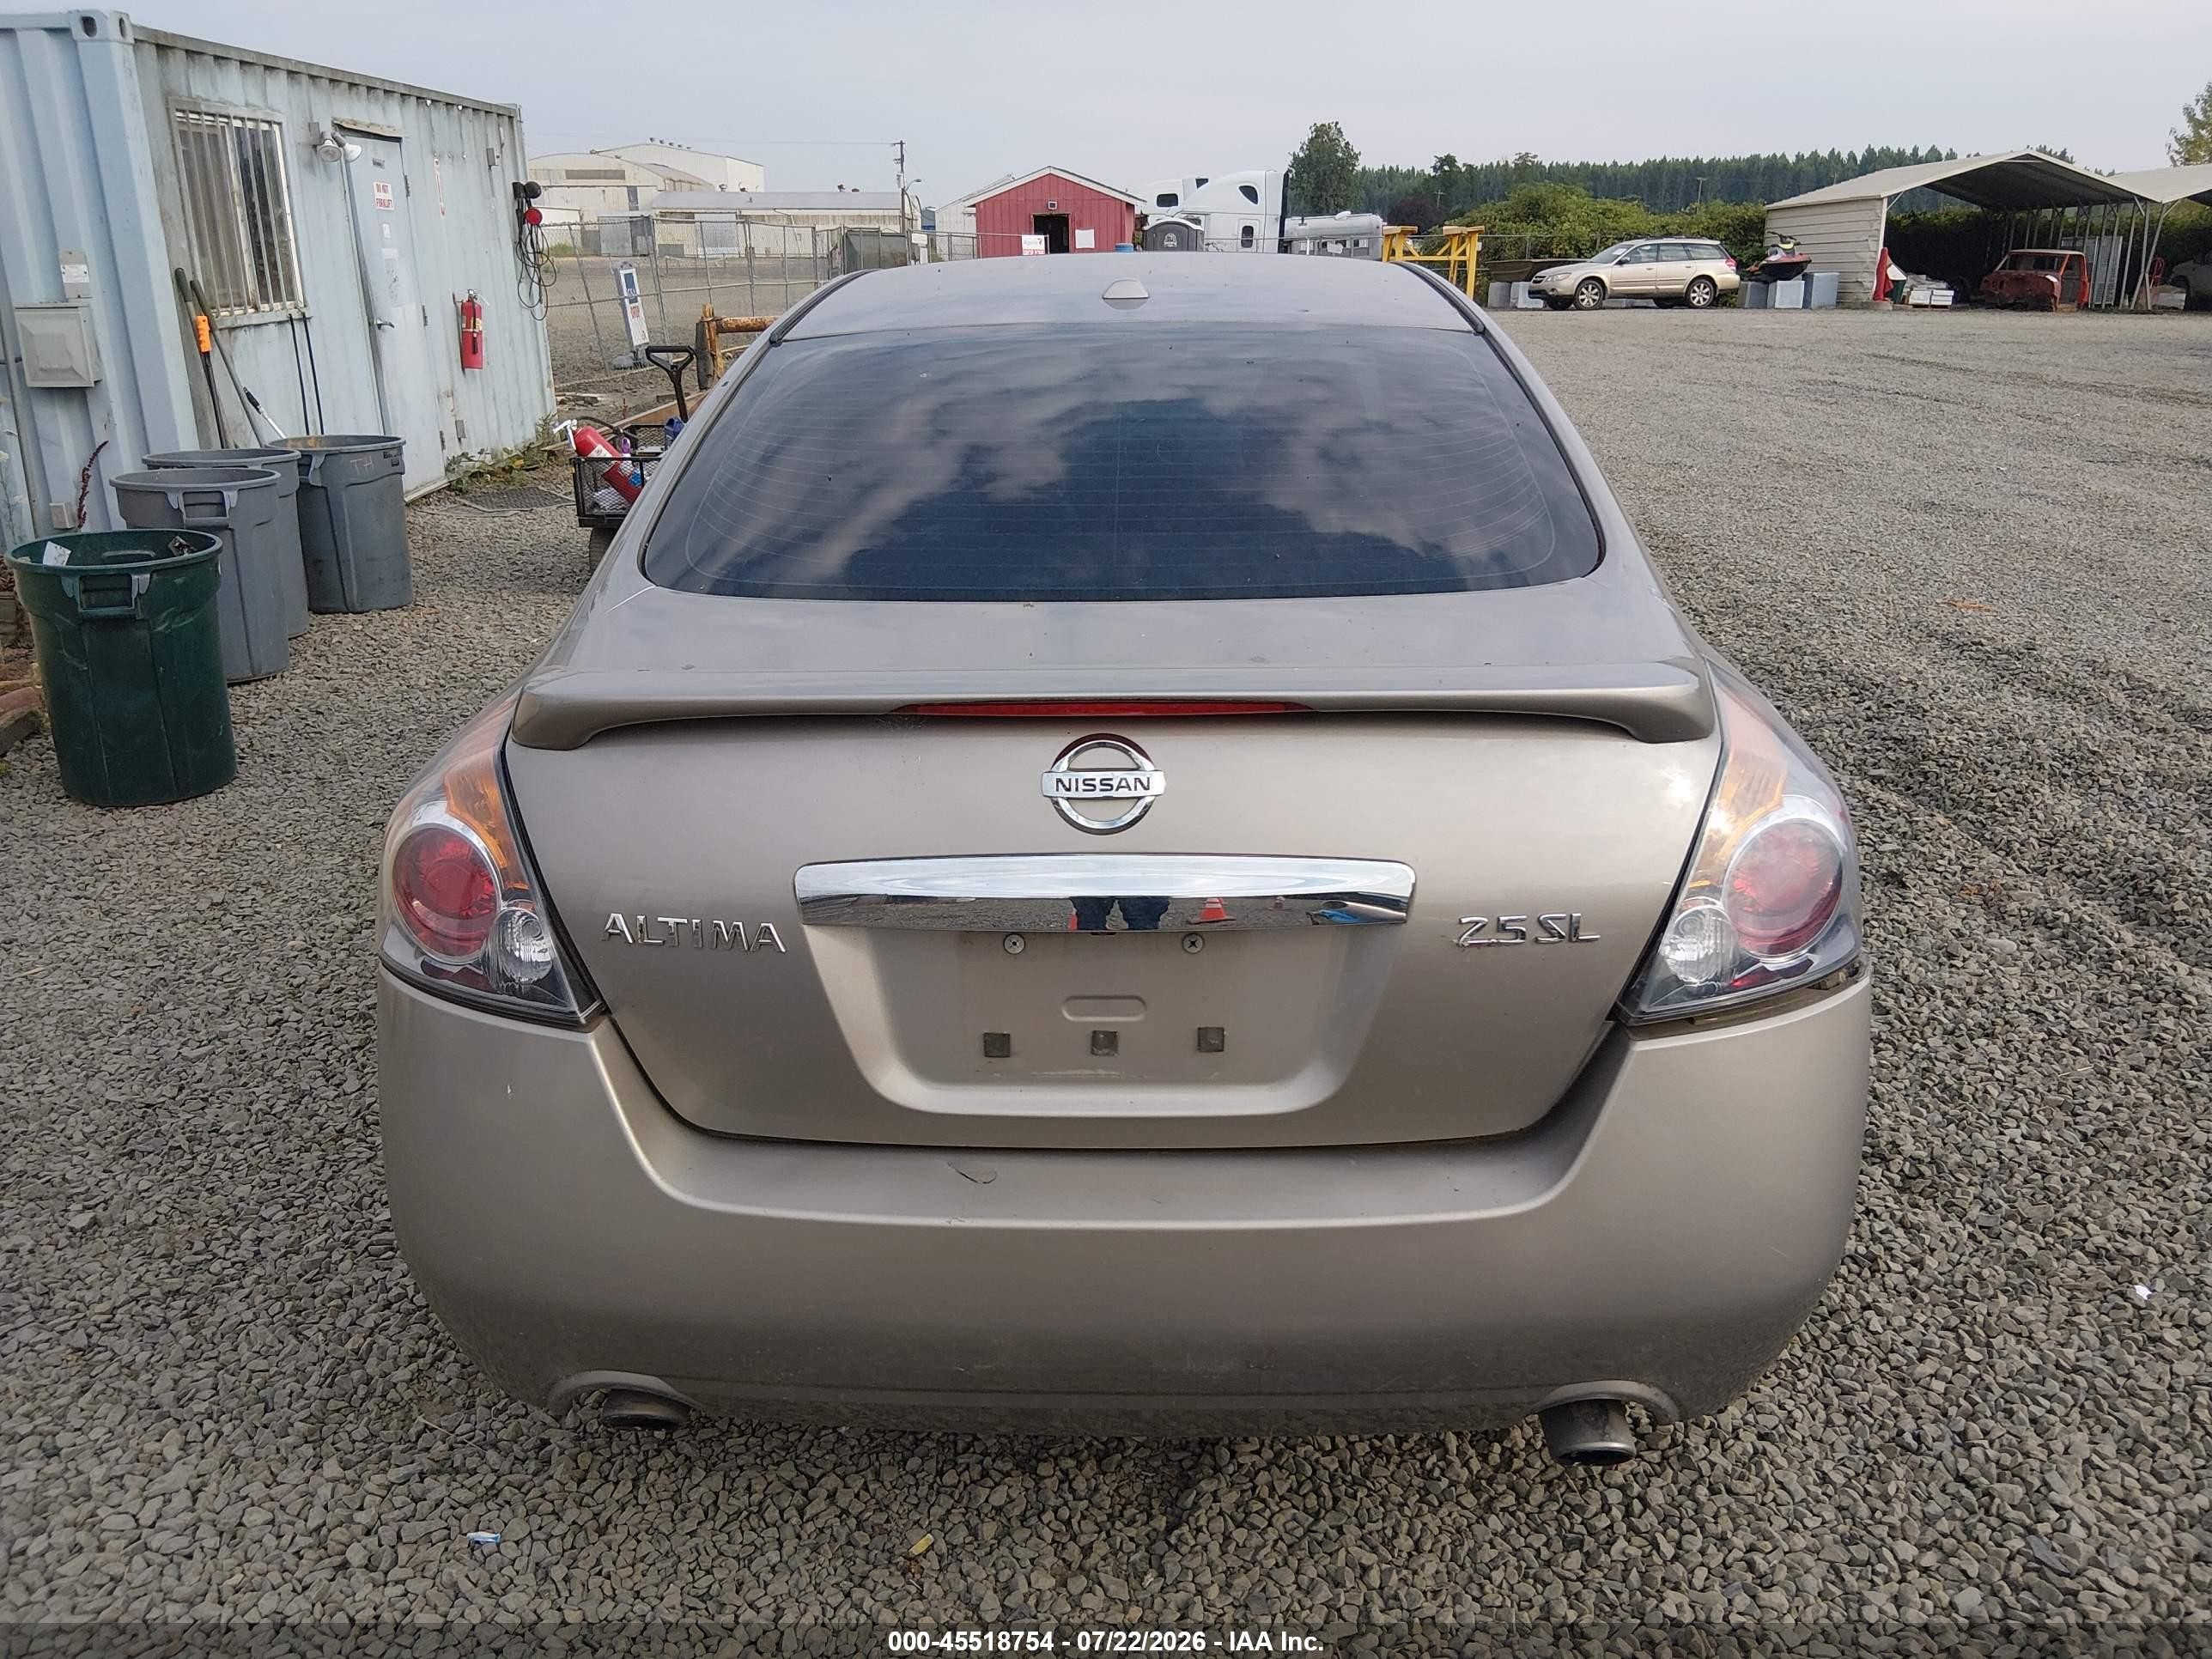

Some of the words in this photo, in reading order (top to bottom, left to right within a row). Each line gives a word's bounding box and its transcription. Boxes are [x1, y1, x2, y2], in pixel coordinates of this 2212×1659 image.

[1055, 777, 1151, 792] NISSAN
[601, 912, 787, 953] ALTIMA
[1535, 913, 1601, 944] SL
